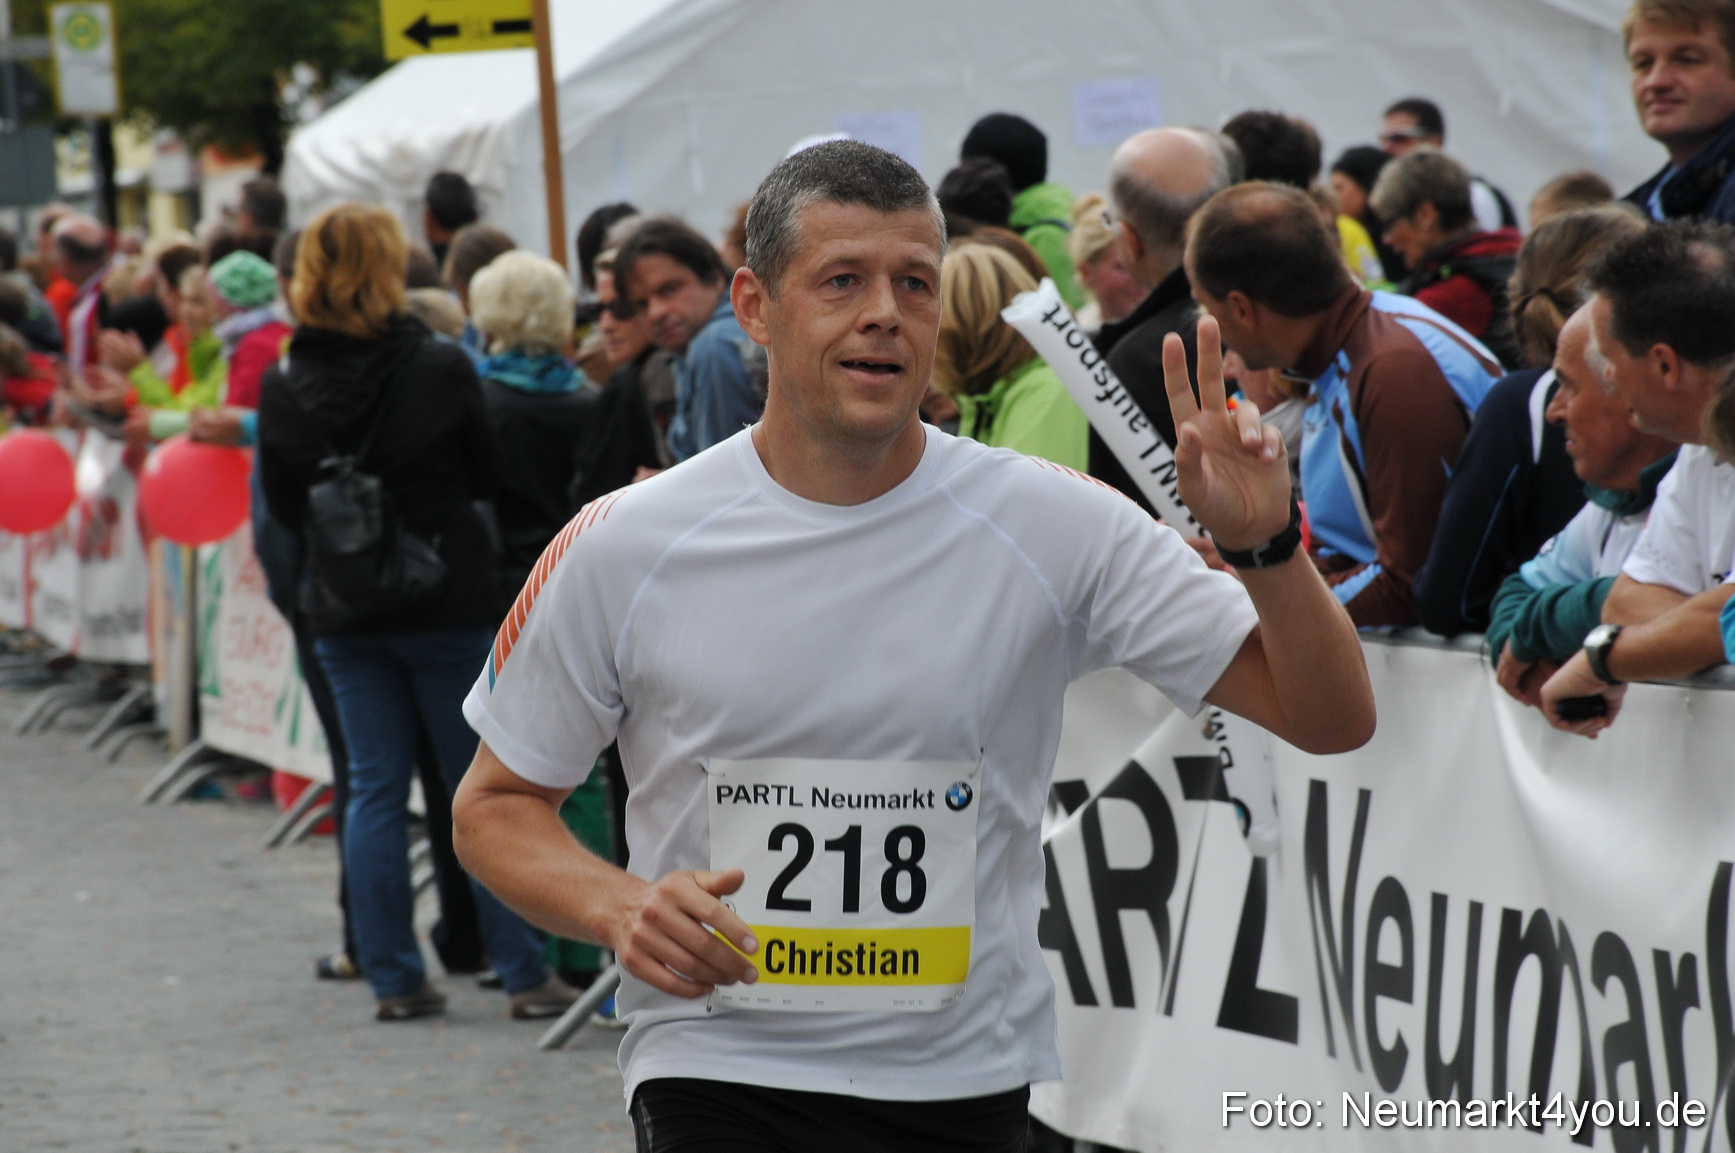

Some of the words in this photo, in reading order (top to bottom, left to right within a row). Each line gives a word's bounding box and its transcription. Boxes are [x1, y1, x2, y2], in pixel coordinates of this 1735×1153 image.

[1040, 301, 1163, 461] Laufsport
[716, 784, 804, 807] PARTL
[811, 787, 936, 809] Neumarkt
[765, 822, 928, 914] 218
[1037, 755, 1299, 1045] ARTL
[765, 939, 920, 977] Christian
